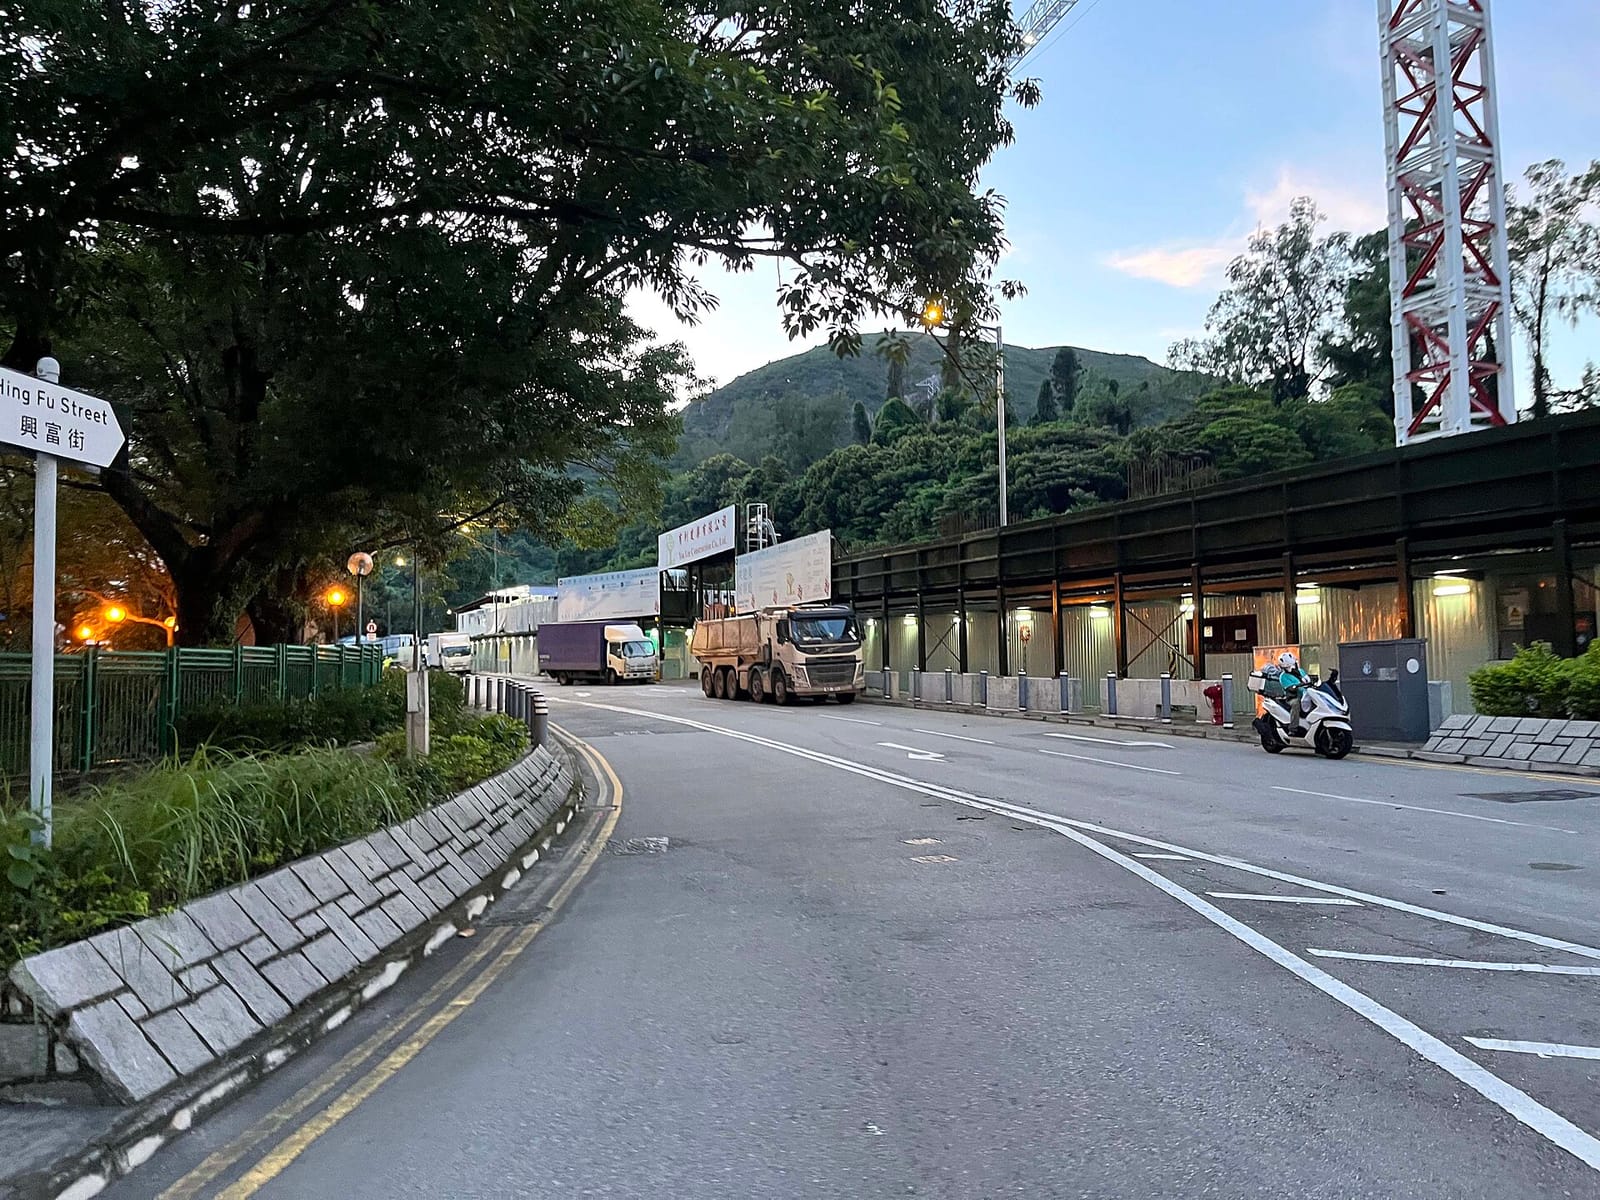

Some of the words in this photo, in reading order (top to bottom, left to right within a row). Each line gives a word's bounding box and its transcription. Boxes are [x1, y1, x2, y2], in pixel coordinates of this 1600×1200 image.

[0, 378, 30, 405] Hing
[37, 390, 55, 409] Fu
[61, 397, 108, 425] Street
[20, 415, 85, 451] 興富街
